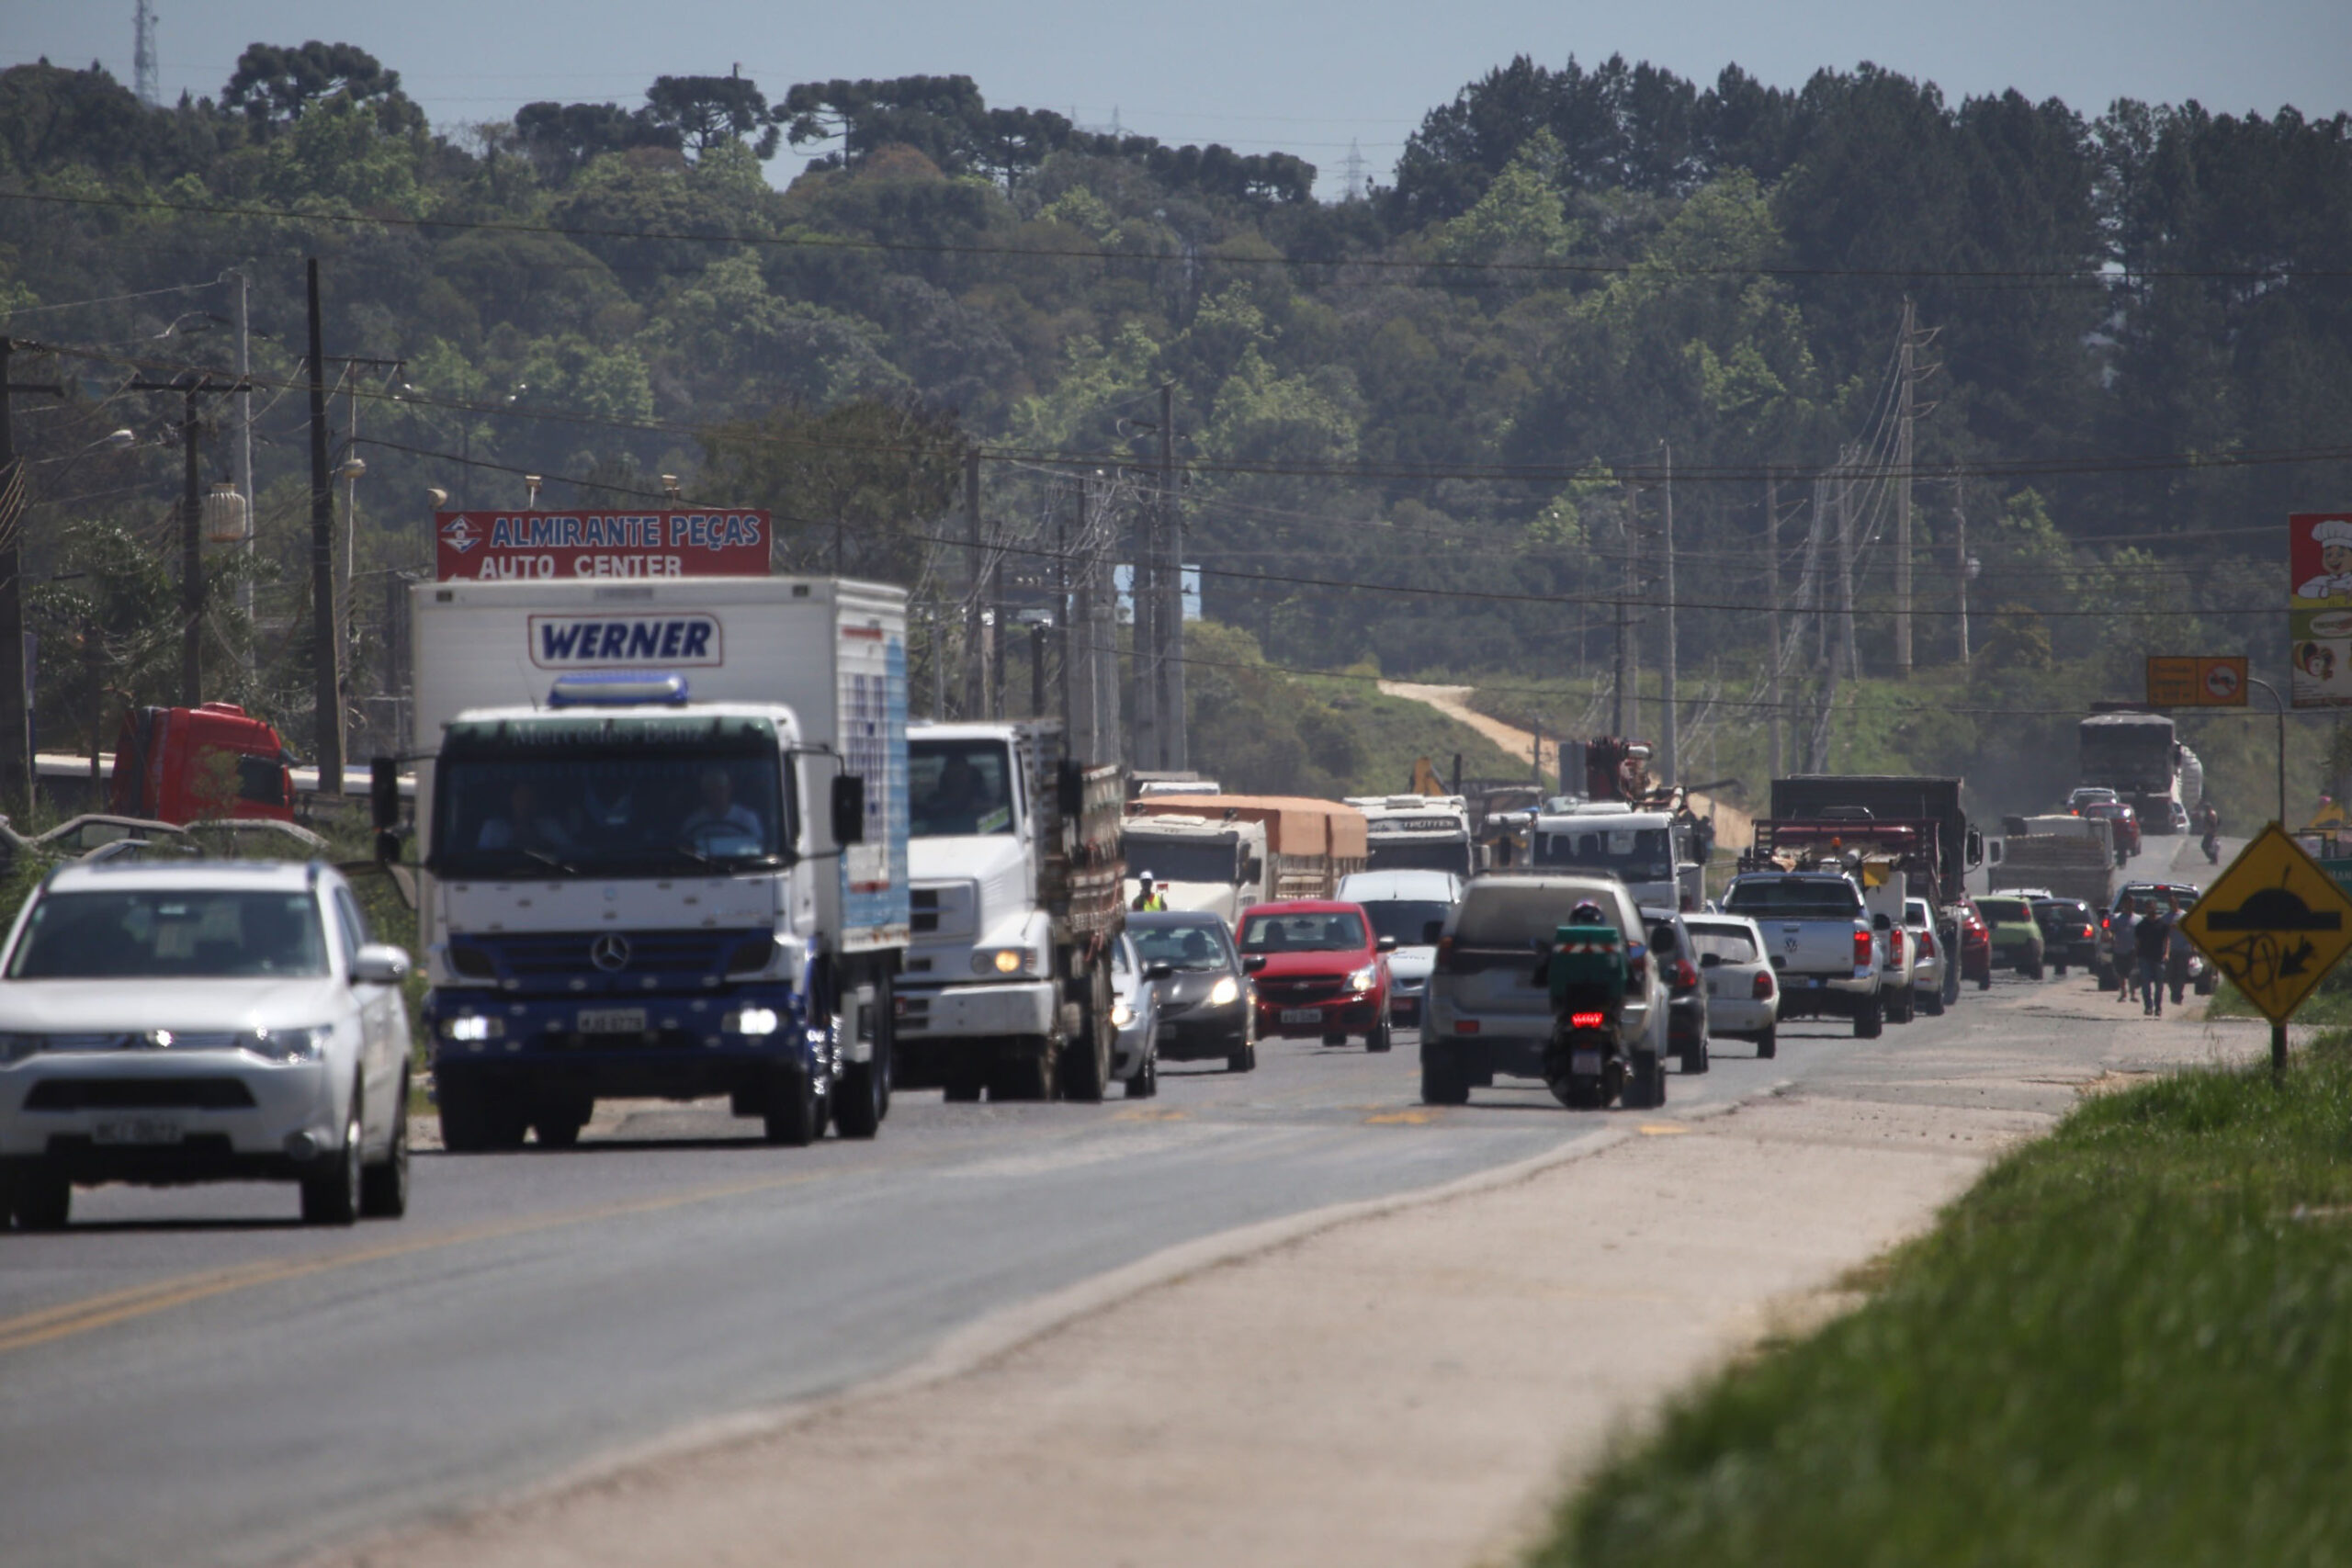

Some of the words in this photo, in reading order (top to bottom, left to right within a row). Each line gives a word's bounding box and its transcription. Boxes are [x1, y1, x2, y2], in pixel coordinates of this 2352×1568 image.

[490, 515, 661, 547] ALMIRANTE
[670, 514, 762, 551] PEÇAS
[480, 555, 555, 580] AUTO
[574, 555, 682, 578] CENTER
[541, 622, 712, 660] WERNER
